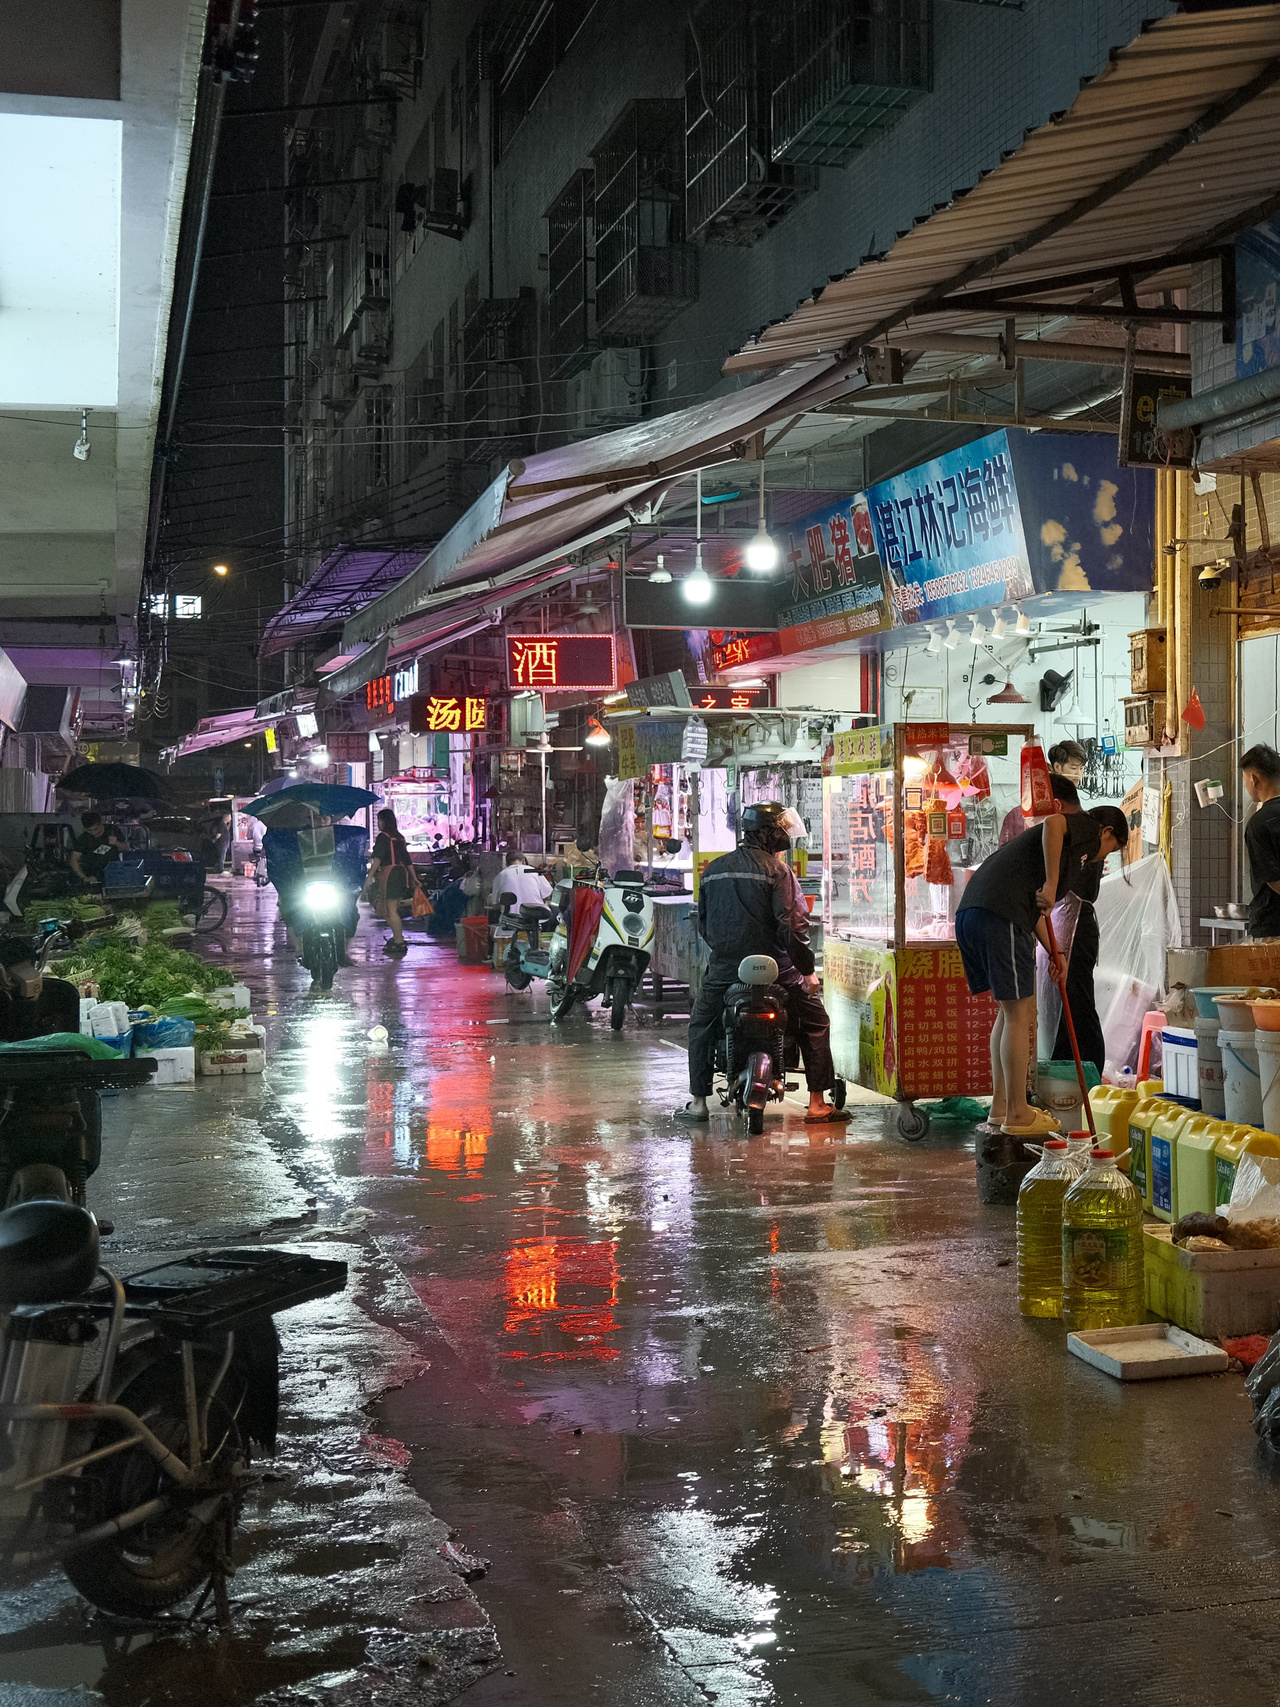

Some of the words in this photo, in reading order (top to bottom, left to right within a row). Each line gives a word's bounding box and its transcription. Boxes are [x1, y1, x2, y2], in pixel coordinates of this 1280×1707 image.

[876, 452, 1016, 571] 湛江林记海鲜
[786, 513, 857, 602] 大肥猪
[512, 641, 558, 684] 酒
[905, 725, 949, 740] 有热米饭
[898, 949, 967, 980] 烧腊
[903, 983, 957, 995] 烧鸭饭
[903, 1008, 957, 1019] 烧鸡饭
[903, 1020, 957, 1032] 白切鸡饭
[903, 1033, 957, 1044] 白切鸭饭
[903, 1045, 957, 1056] 卤鸭/鸡饭
[903, 1057, 957, 1069] 卤水双拼
[903, 1082, 957, 1094] 烧猪肉饭
